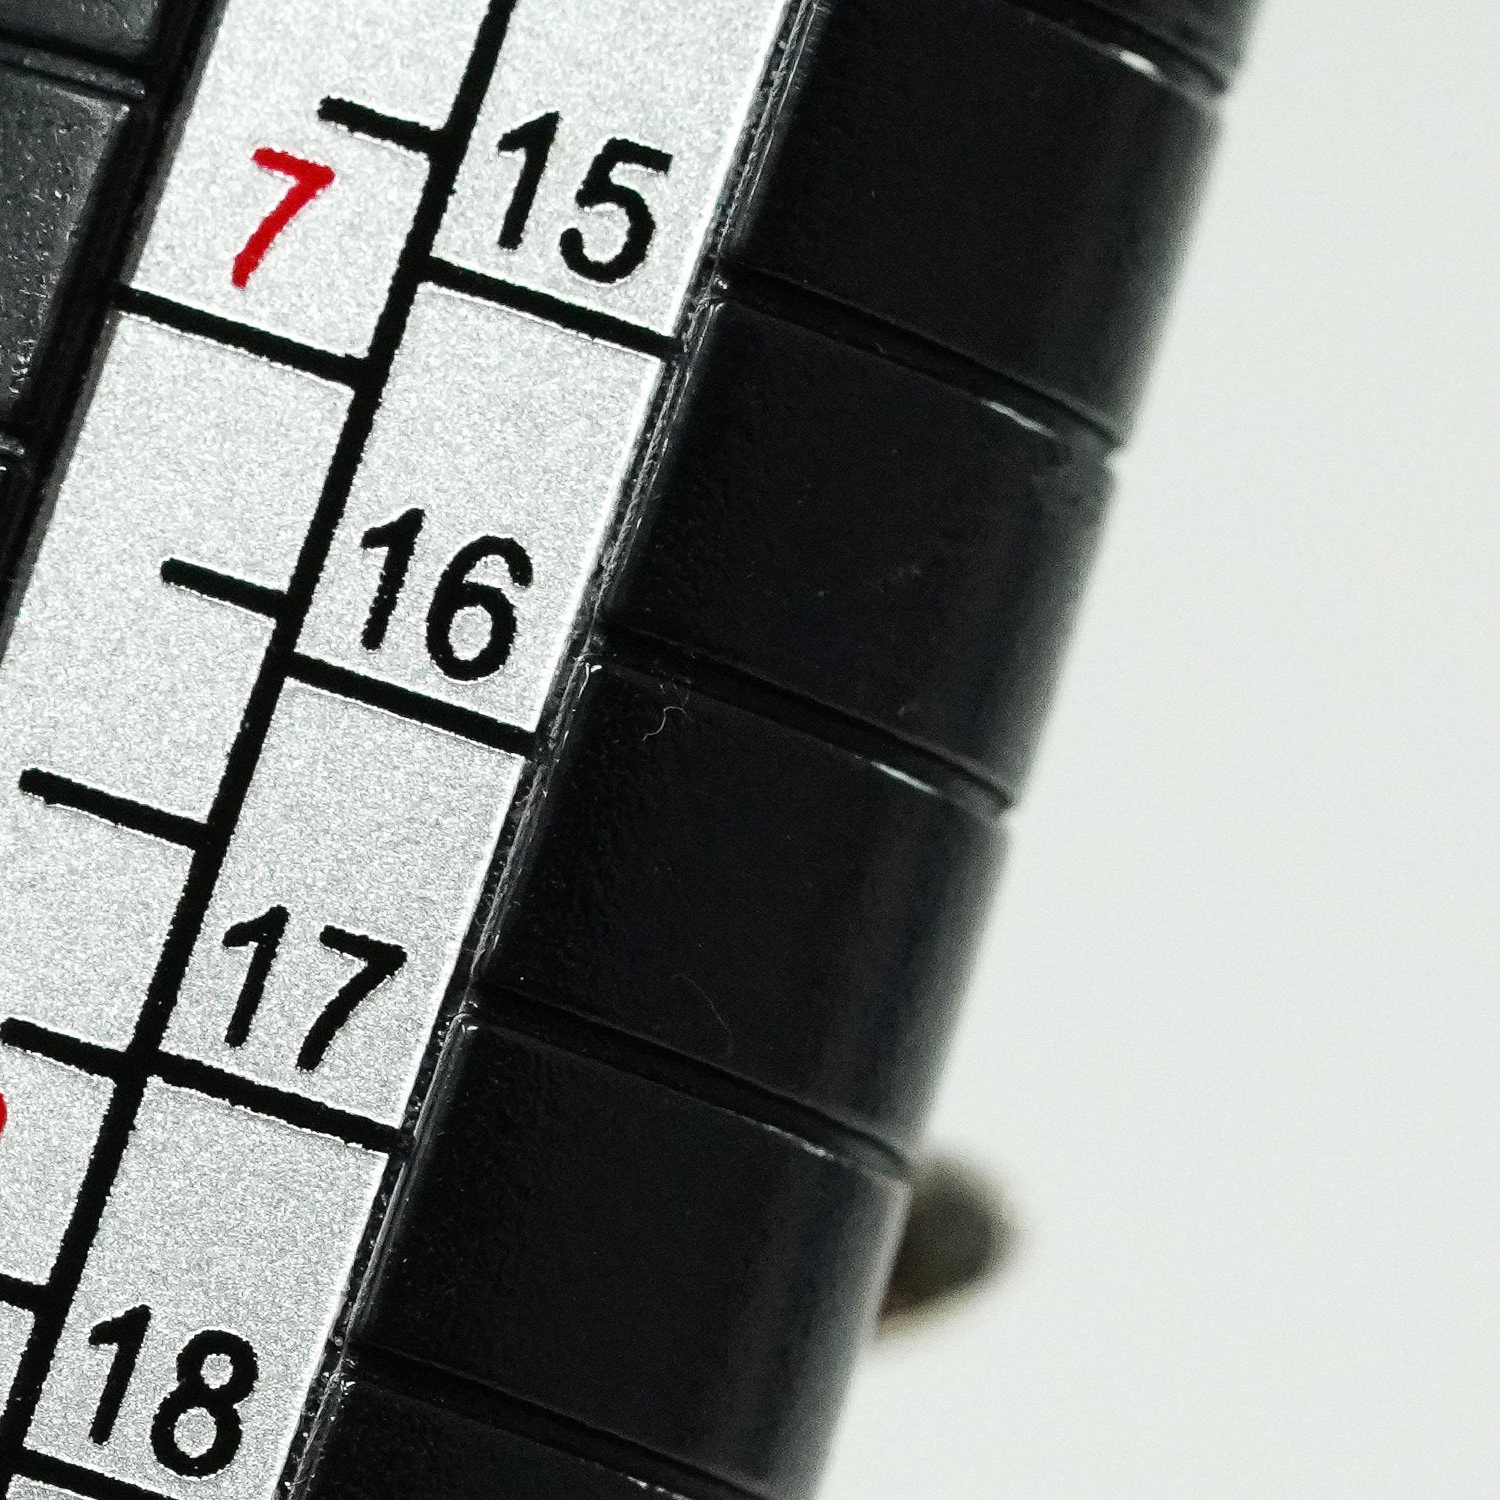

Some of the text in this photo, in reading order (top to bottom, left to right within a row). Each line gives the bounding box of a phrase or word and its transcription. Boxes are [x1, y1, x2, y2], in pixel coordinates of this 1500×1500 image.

[233, 148, 334, 288] 7
[498, 111, 673, 284] 15
[361, 509, 534, 682] 16
[222, 905, 407, 1073] 17
[89, 1304, 260, 1480] 18
